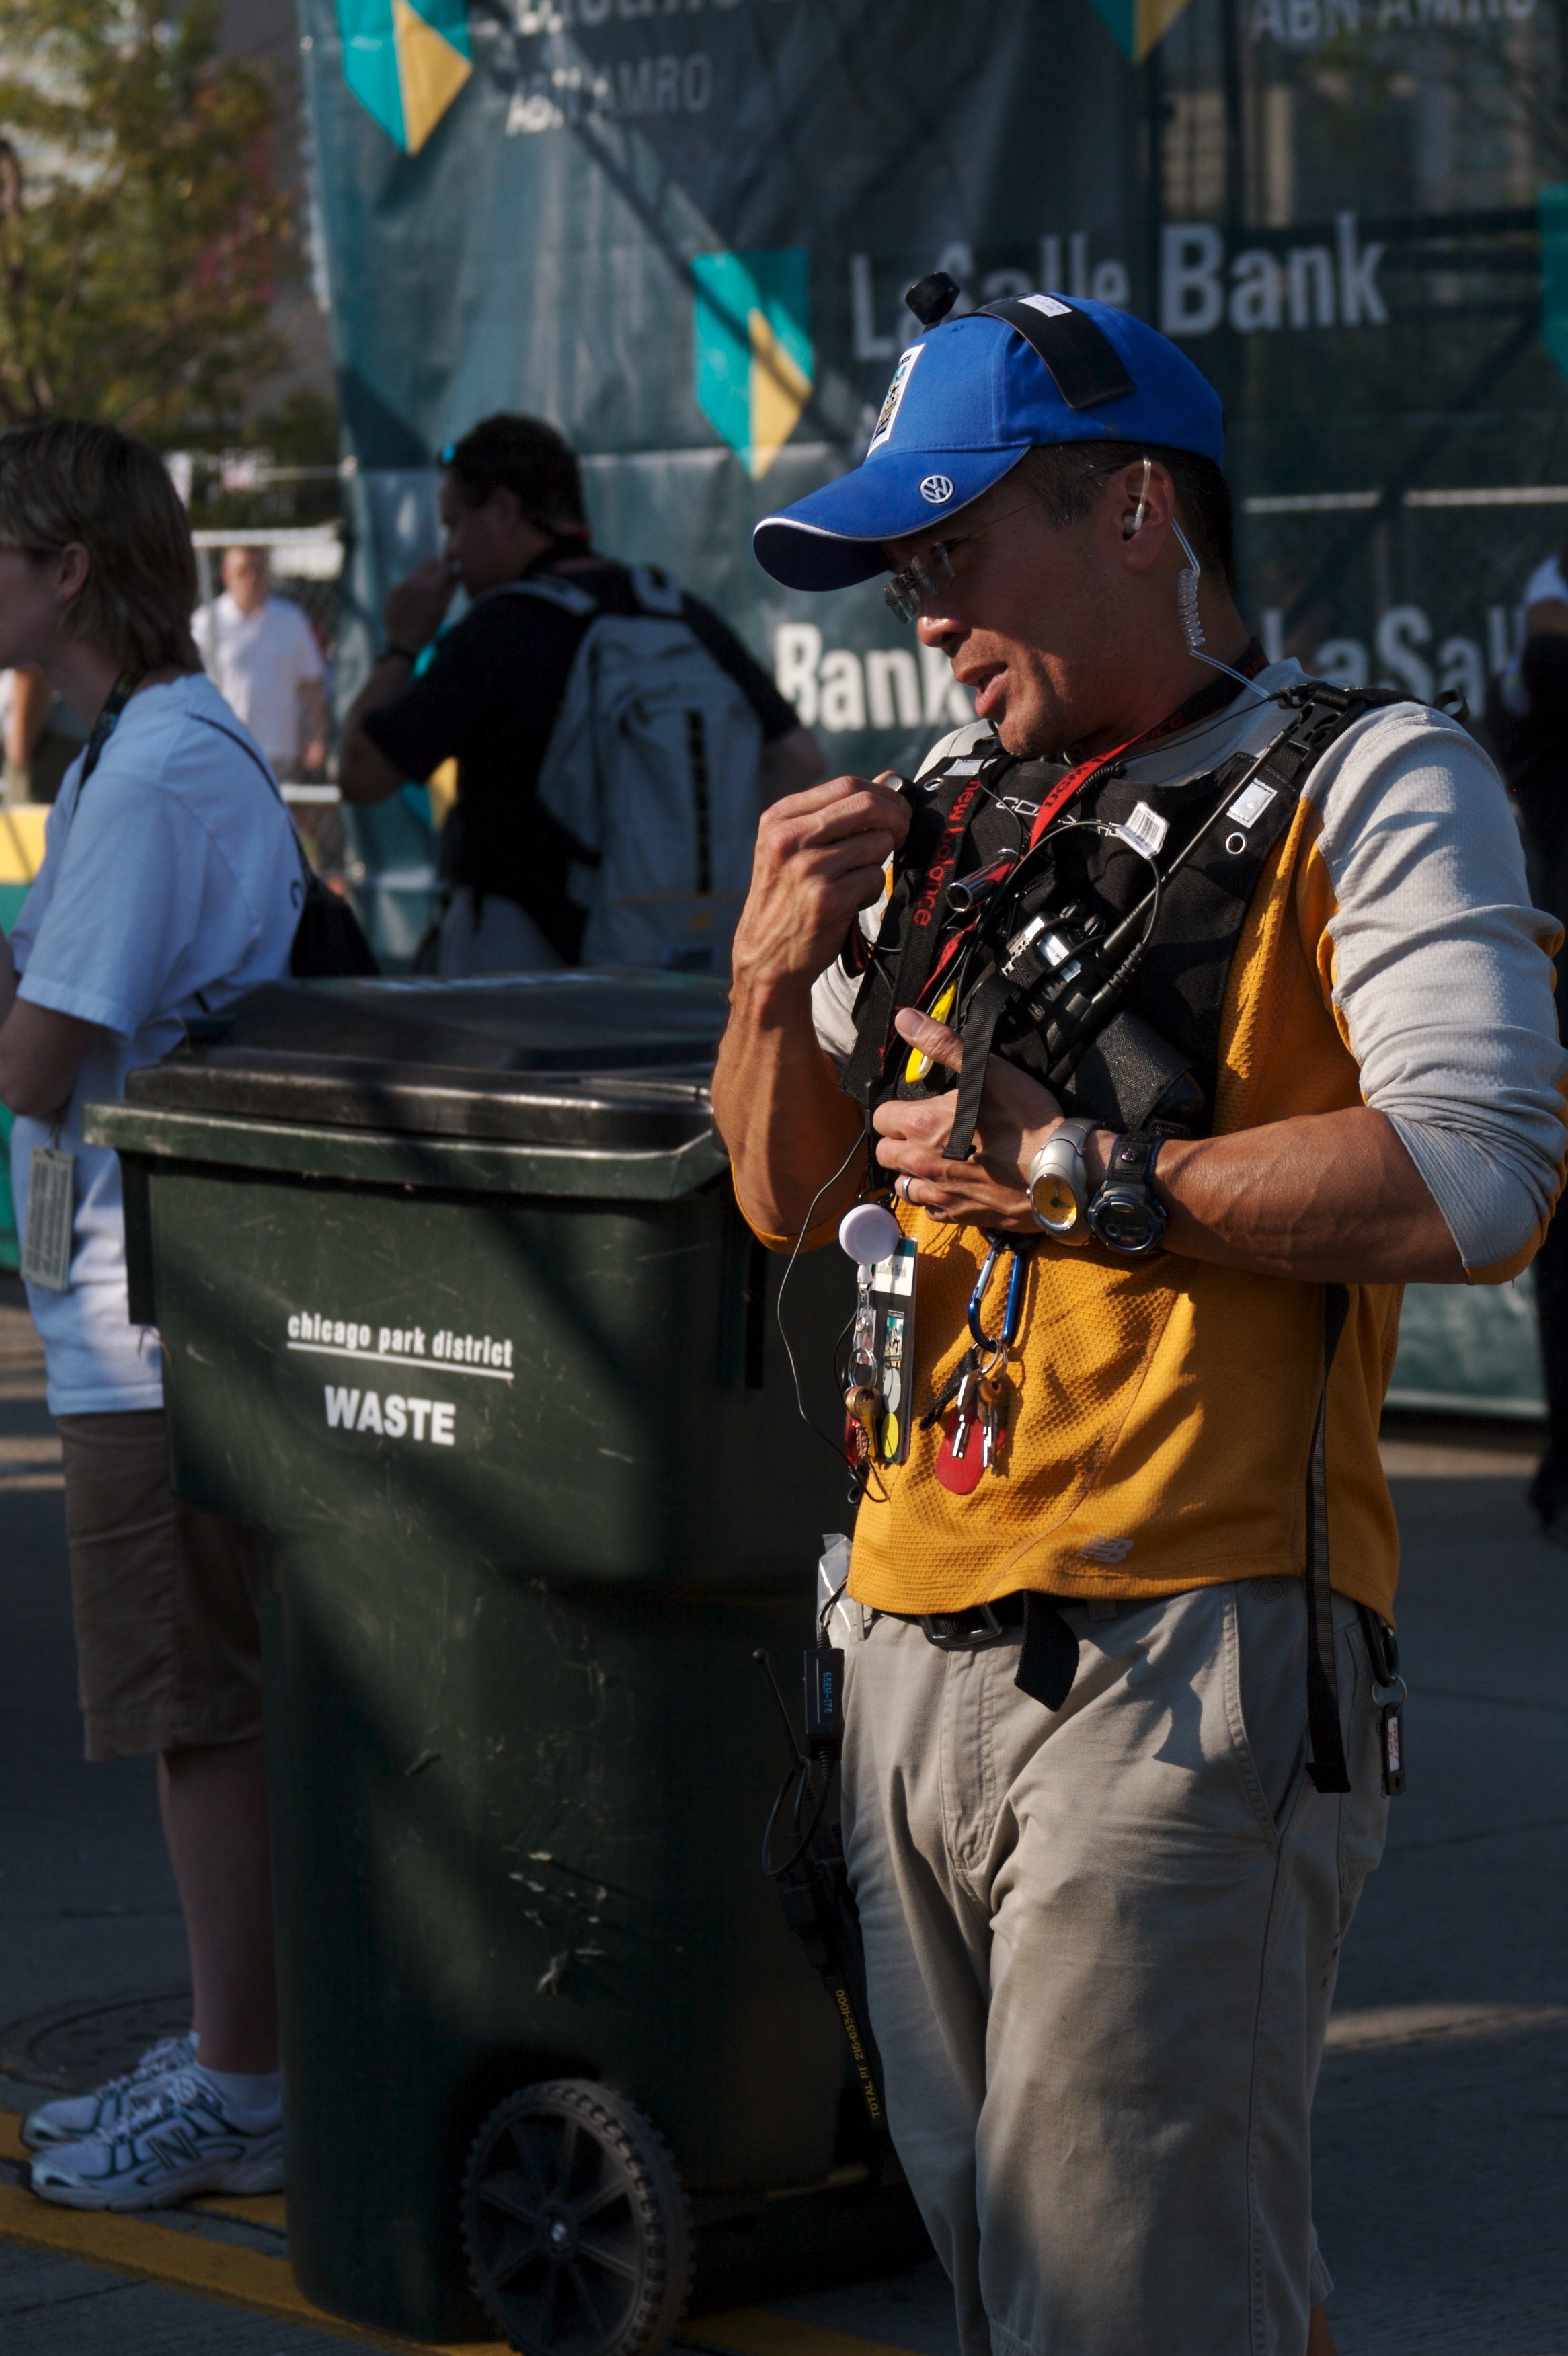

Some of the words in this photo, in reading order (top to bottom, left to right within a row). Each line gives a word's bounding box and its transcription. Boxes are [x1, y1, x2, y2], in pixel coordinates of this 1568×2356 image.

[1159, 210, 1390, 336] Bank
[913, 825, 966, 927] balance
[287, 1311, 371, 1349] chicago
[378, 1325, 426, 1356] park
[432, 1329, 514, 1368] district
[324, 1384, 457, 1446] WASTE
[865, 2080, 881, 2119] TOTAL
